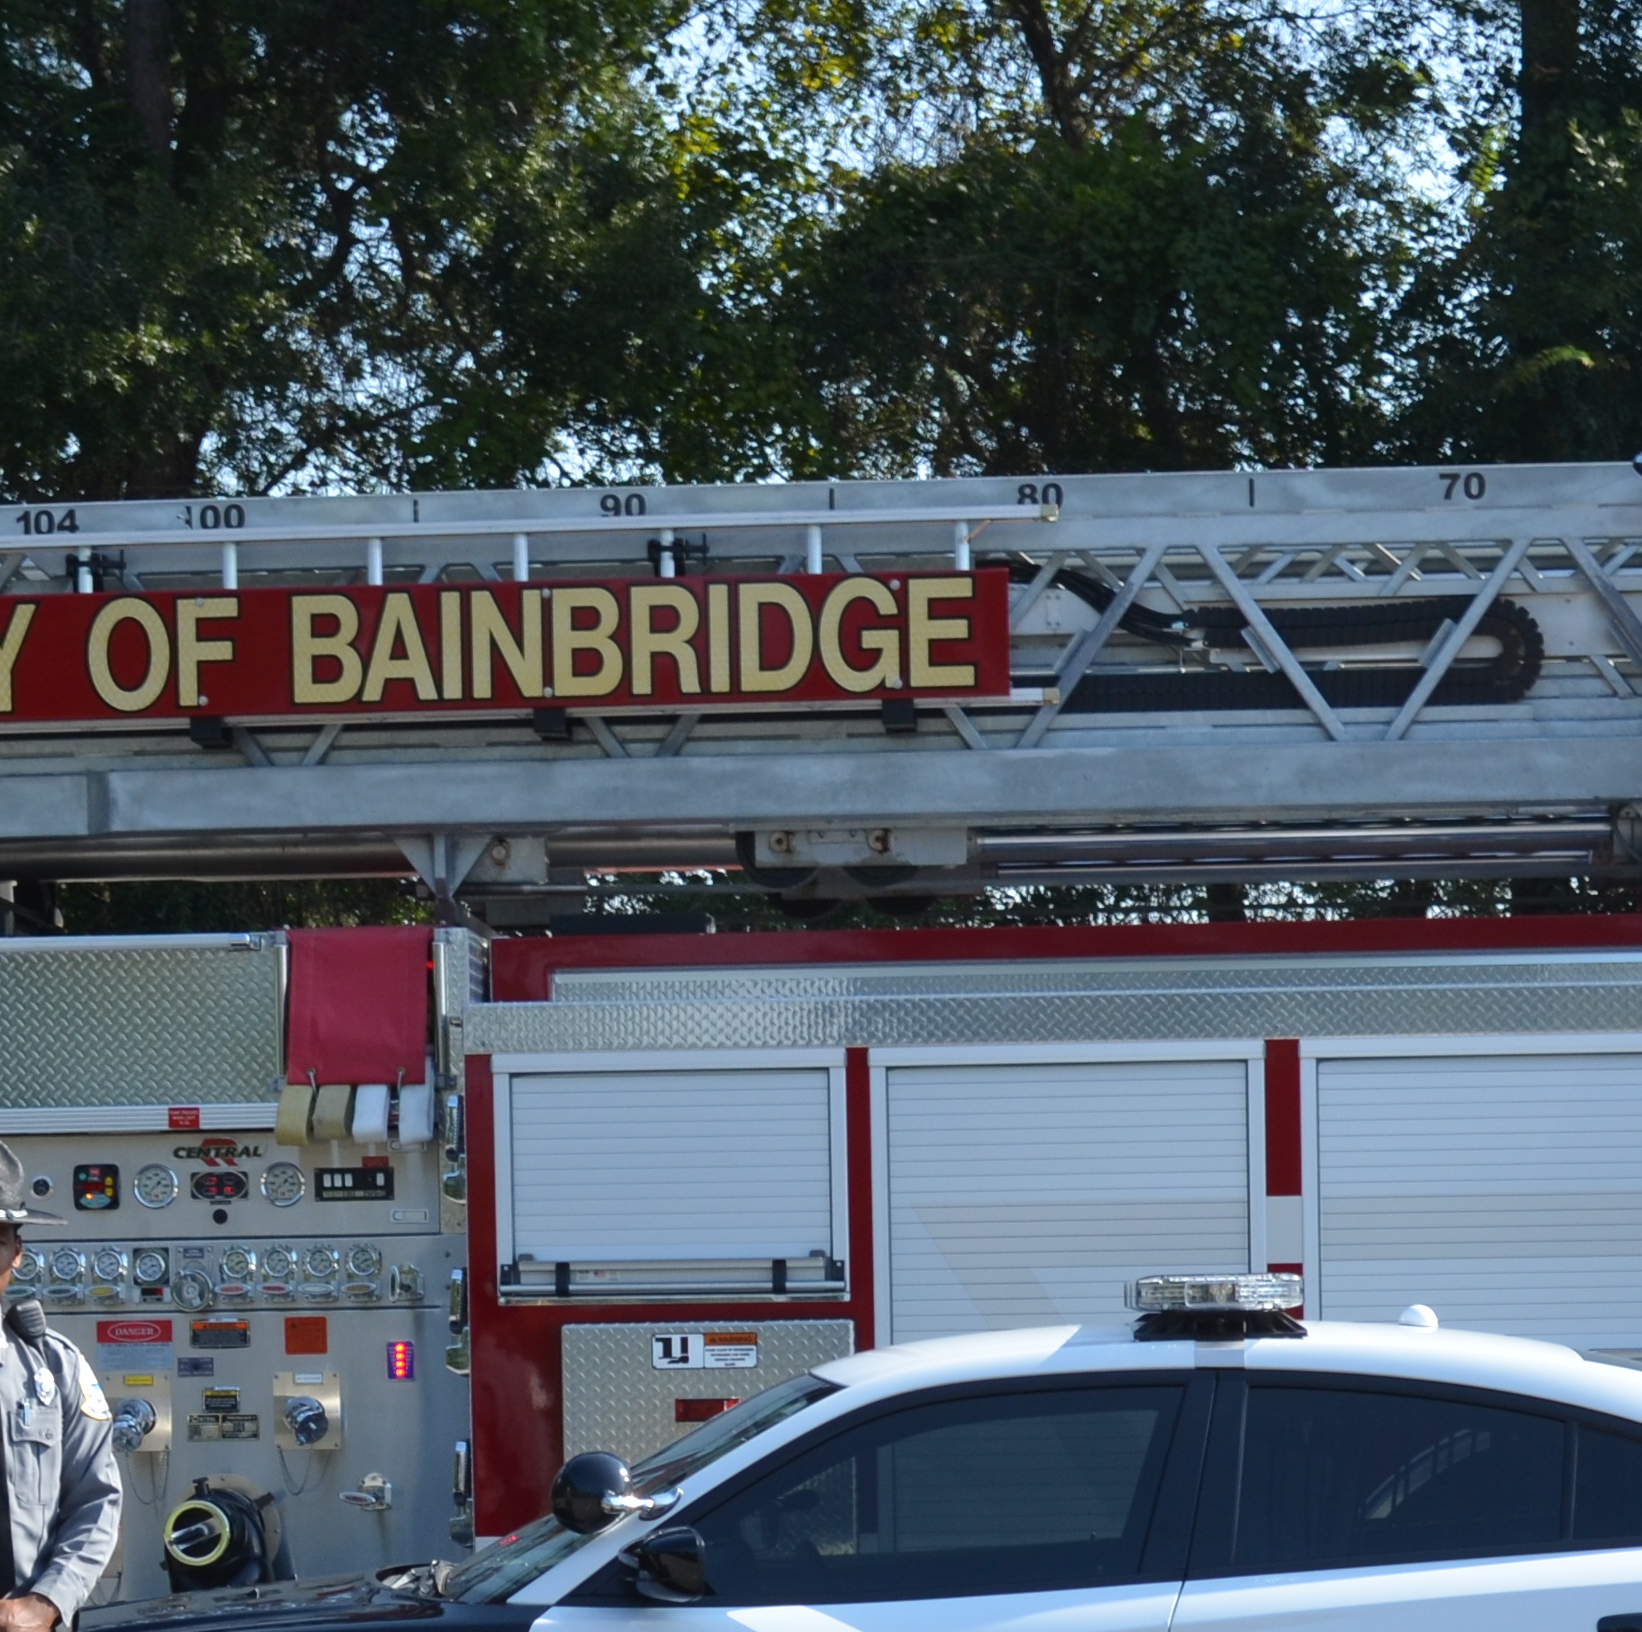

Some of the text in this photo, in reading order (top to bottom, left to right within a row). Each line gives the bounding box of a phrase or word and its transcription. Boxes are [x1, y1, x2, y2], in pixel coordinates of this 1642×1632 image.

[1018, 483, 1063, 509] 80
[1438, 473, 1487, 501] 70
[600, 494, 647, 517] 90
[16, 509, 79, 535] 104
[87, 596, 239, 712] OF
[290, 575, 977, 705] BAINBRIDGE
[172, 1146, 263, 1160] CENTRAL
[114, 1327, 155, 1336] DANGER
